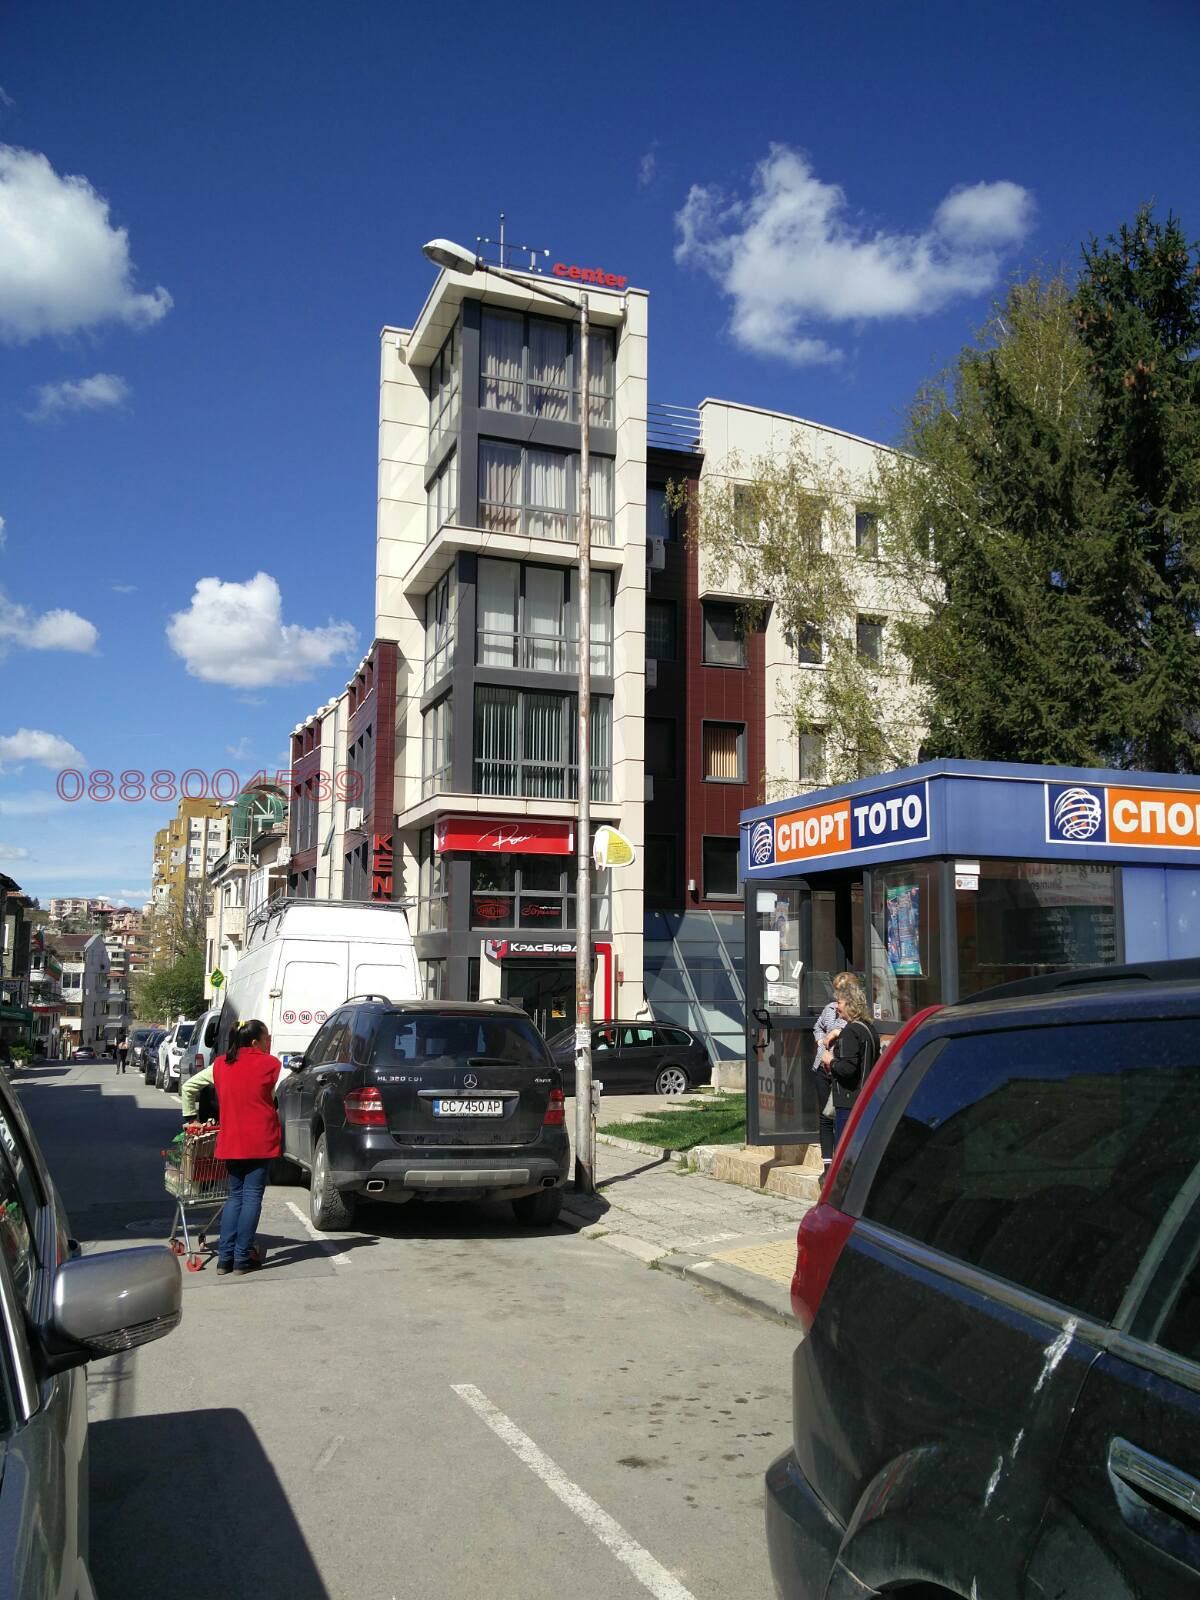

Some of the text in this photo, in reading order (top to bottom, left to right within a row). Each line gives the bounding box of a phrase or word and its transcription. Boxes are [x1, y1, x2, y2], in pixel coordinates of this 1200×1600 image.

[553, 262, 628, 288] center
[777, 794, 922, 853] СПОРТ ТОТО
[1112, 799, 1200, 836] СПО
[372, 833, 393, 902] KEN
